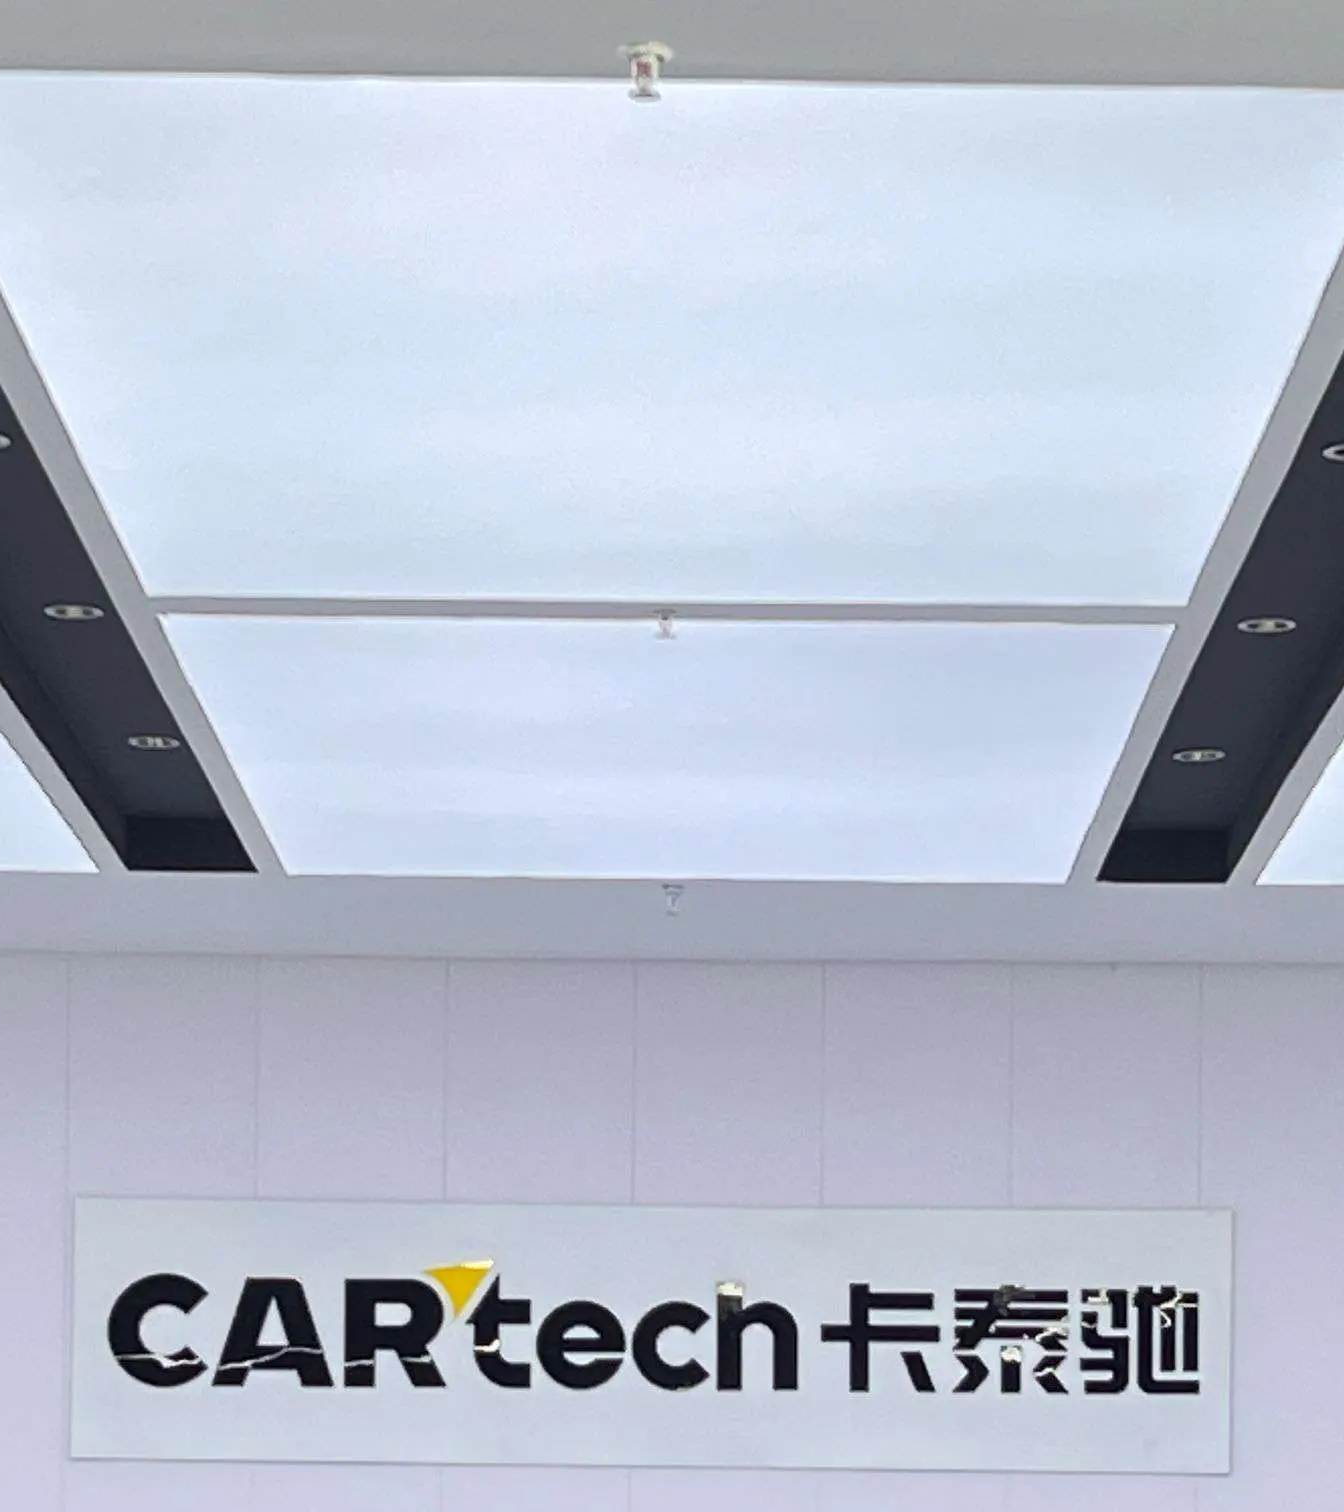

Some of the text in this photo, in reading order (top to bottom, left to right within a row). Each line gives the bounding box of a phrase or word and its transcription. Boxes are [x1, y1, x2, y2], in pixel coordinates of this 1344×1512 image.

[107, 1262, 1200, 1395] CARtech 卡泰驰
